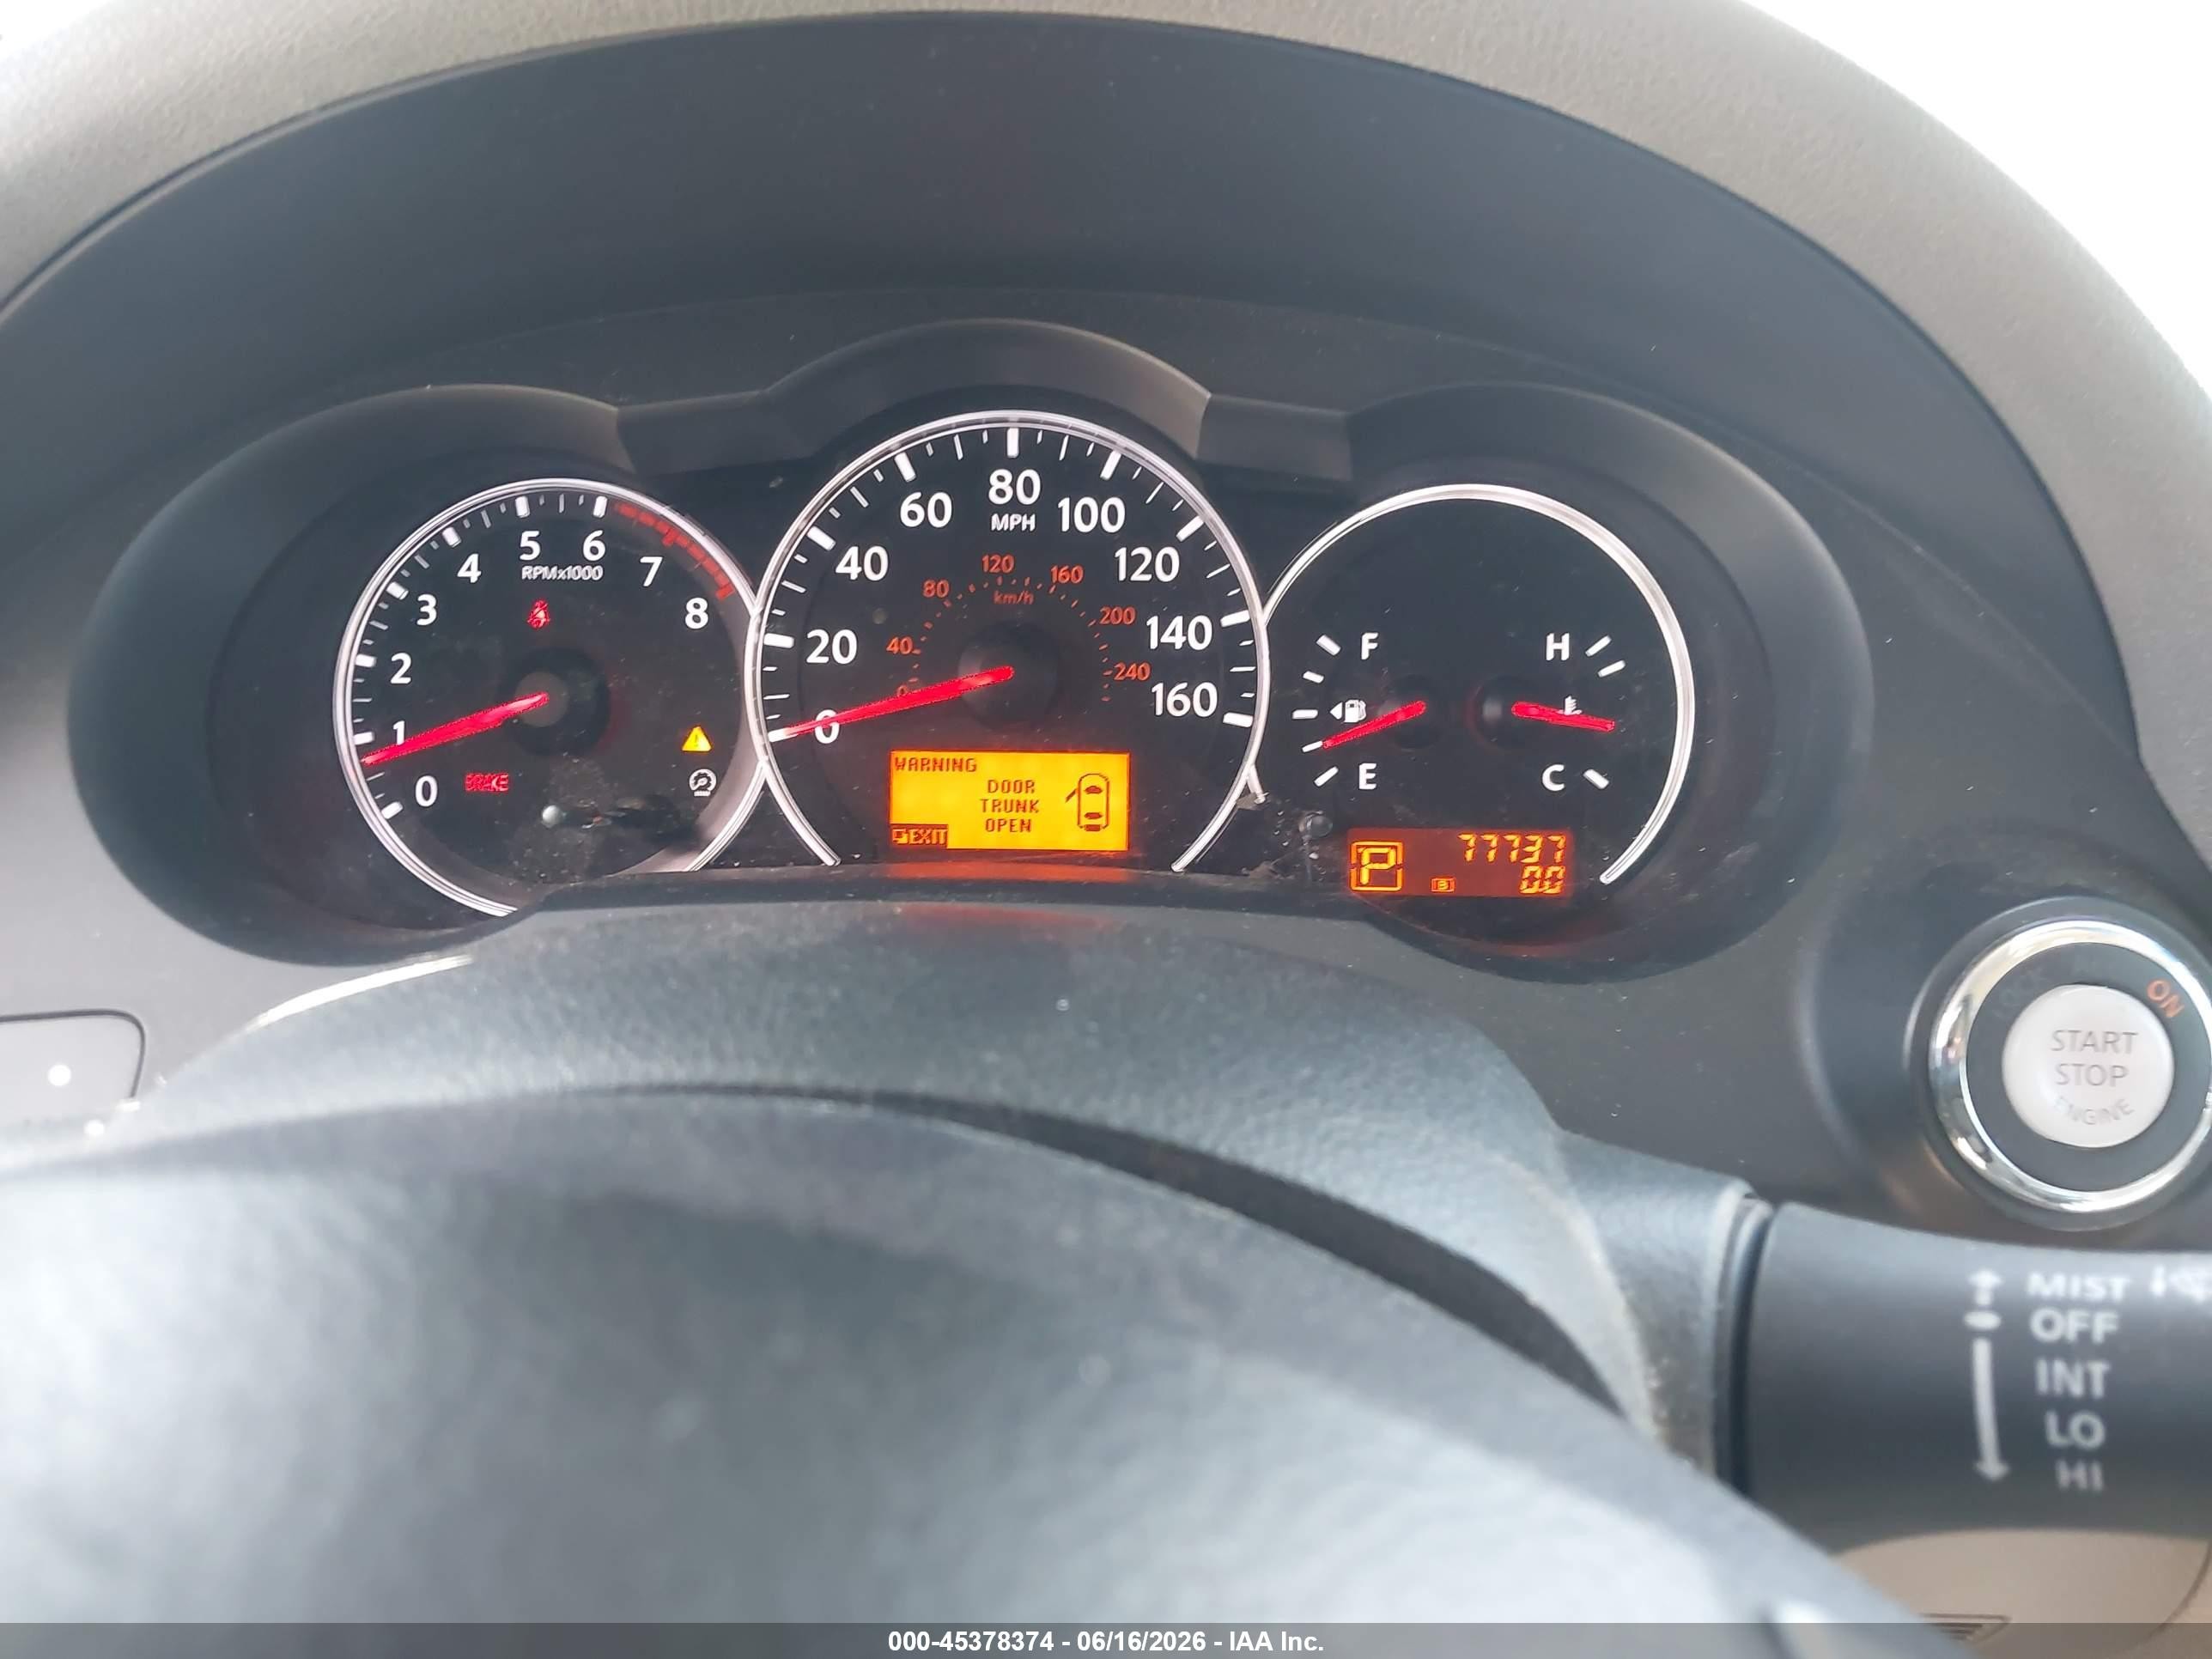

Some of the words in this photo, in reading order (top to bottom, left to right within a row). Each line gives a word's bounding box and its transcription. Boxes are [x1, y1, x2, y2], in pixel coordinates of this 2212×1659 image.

[988, 468, 1041, 505] 80
[900, 491, 952, 528] 60
[991, 513, 1036, 532] MPH
[1057, 496, 1126, 533] 100
[520, 530, 541, 561] 5
[582, 530, 606, 562] 6
[457, 553, 482, 583] 4
[521, 565, 604, 580] RPMx1000
[640, 556, 663, 587] 7
[836, 545, 889, 581] 40
[981, 555, 1015, 574] 120
[1050, 565, 1085, 585] 160
[1115, 546, 1180, 582] 120
[922, 580, 950, 599] 80
[993, 590, 1034, 606] km/h
[416, 593, 437, 626] 3
[684, 597, 709, 629] 8
[1099, 606, 1136, 626] 200
[805, 629, 858, 665] 20
[886, 636, 913, 655] 40
[1146, 615, 1212, 651] 140
[1361, 632, 1379, 660] F
[1546, 632, 1571, 661] H
[390, 652, 412, 684] 2
[1114, 662, 1152, 681] 240
[1151, 682, 1218, 718] 160
[392, 720, 405, 745] 1
[814, 709, 841, 744] 0
[894, 757, 977, 772] WARNING
[1358, 763, 1377, 790] E
[1541, 763, 1566, 792] C
[415, 775, 438, 807] 0
[988, 780, 1036, 793] DOOR
[980, 799, 1040, 813] TRUNK
[908, 829, 948, 845] EXIT
[985, 818, 1032, 833] OPEN
[1458, 834, 1566, 864] 77737
[1359, 847, 1396, 885] P
[2147, 980, 2185, 1018] ON
[2051, 1030, 2139, 1055] START
[2054, 1063, 2130, 1088] STOP
[2027, 1271, 2131, 1304] MIST
[2029, 1307, 2120, 1344] OFF
[2034, 1359, 2111, 1399] INT
[2044, 1410, 2106, 1451] LO
[2055, 1459, 2106, 1493] HI
